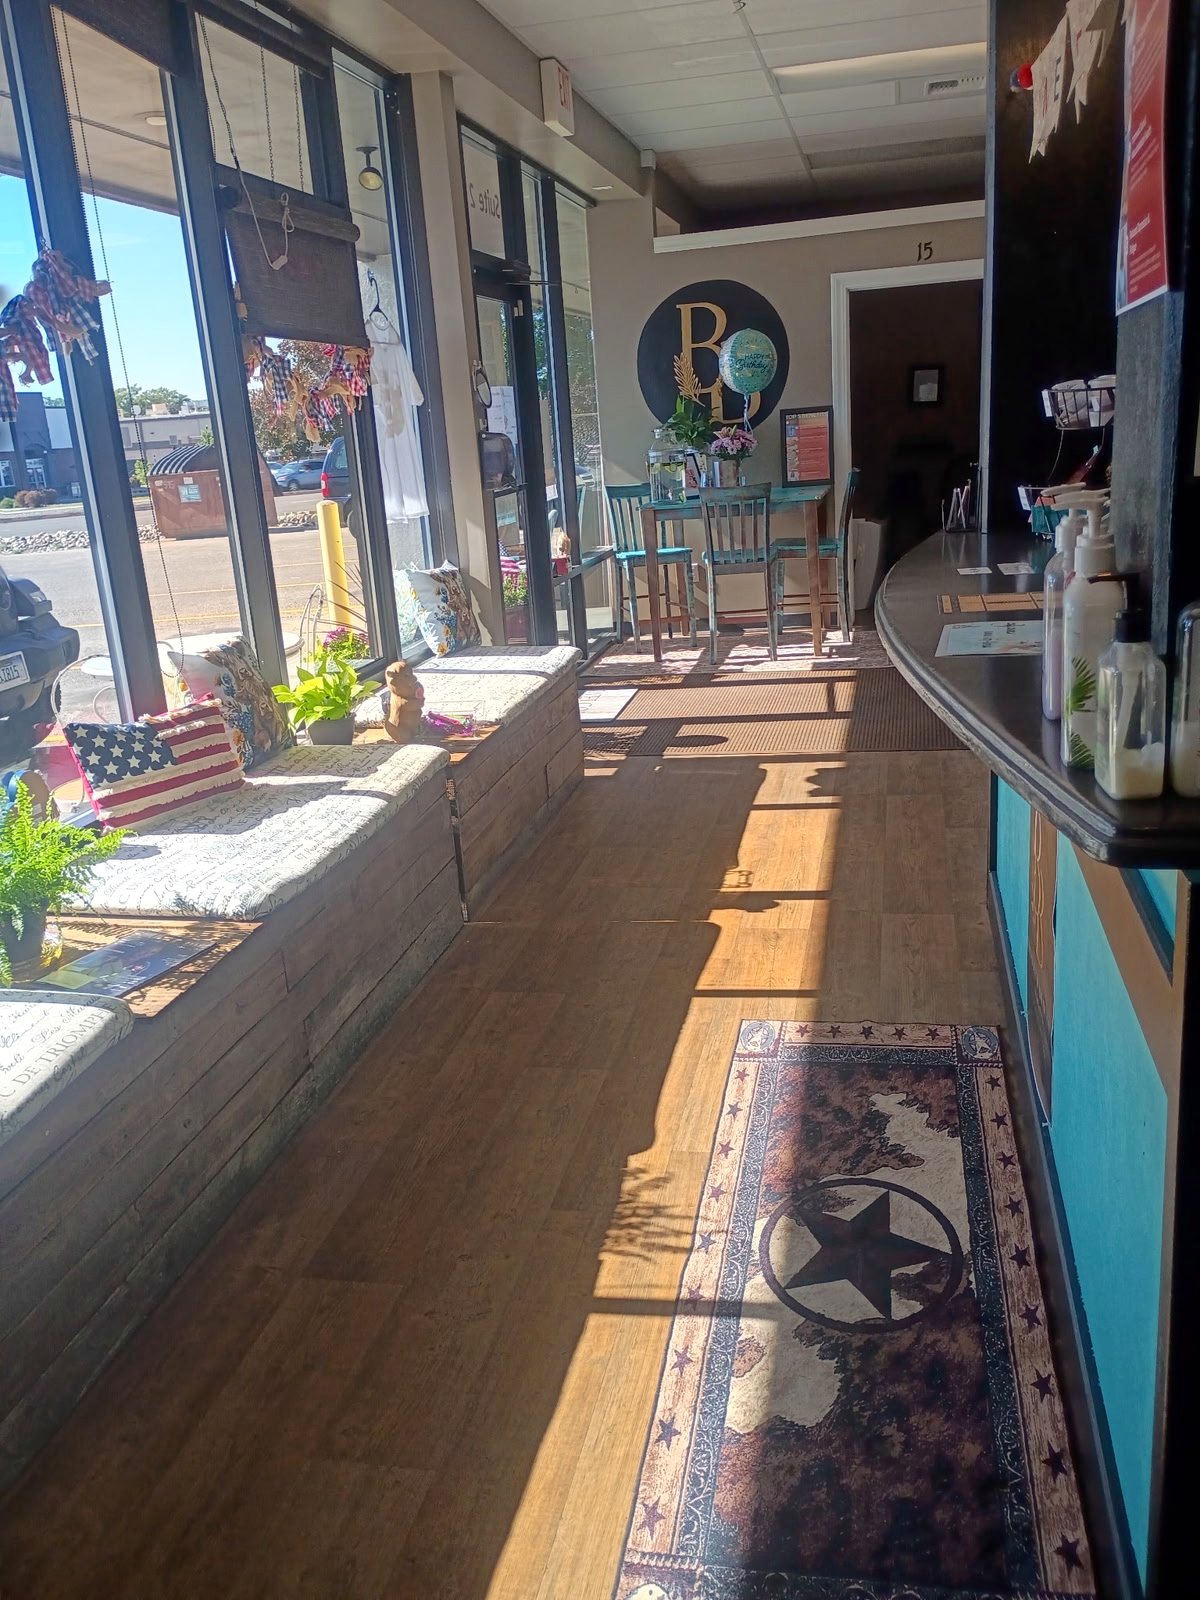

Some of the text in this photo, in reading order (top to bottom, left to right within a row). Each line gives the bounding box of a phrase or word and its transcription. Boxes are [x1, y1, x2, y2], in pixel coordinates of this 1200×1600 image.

[917, 241, 933, 262] 15
[744, 353, 765, 361] HAPPY
[12, 1065, 41, 1085] DE
